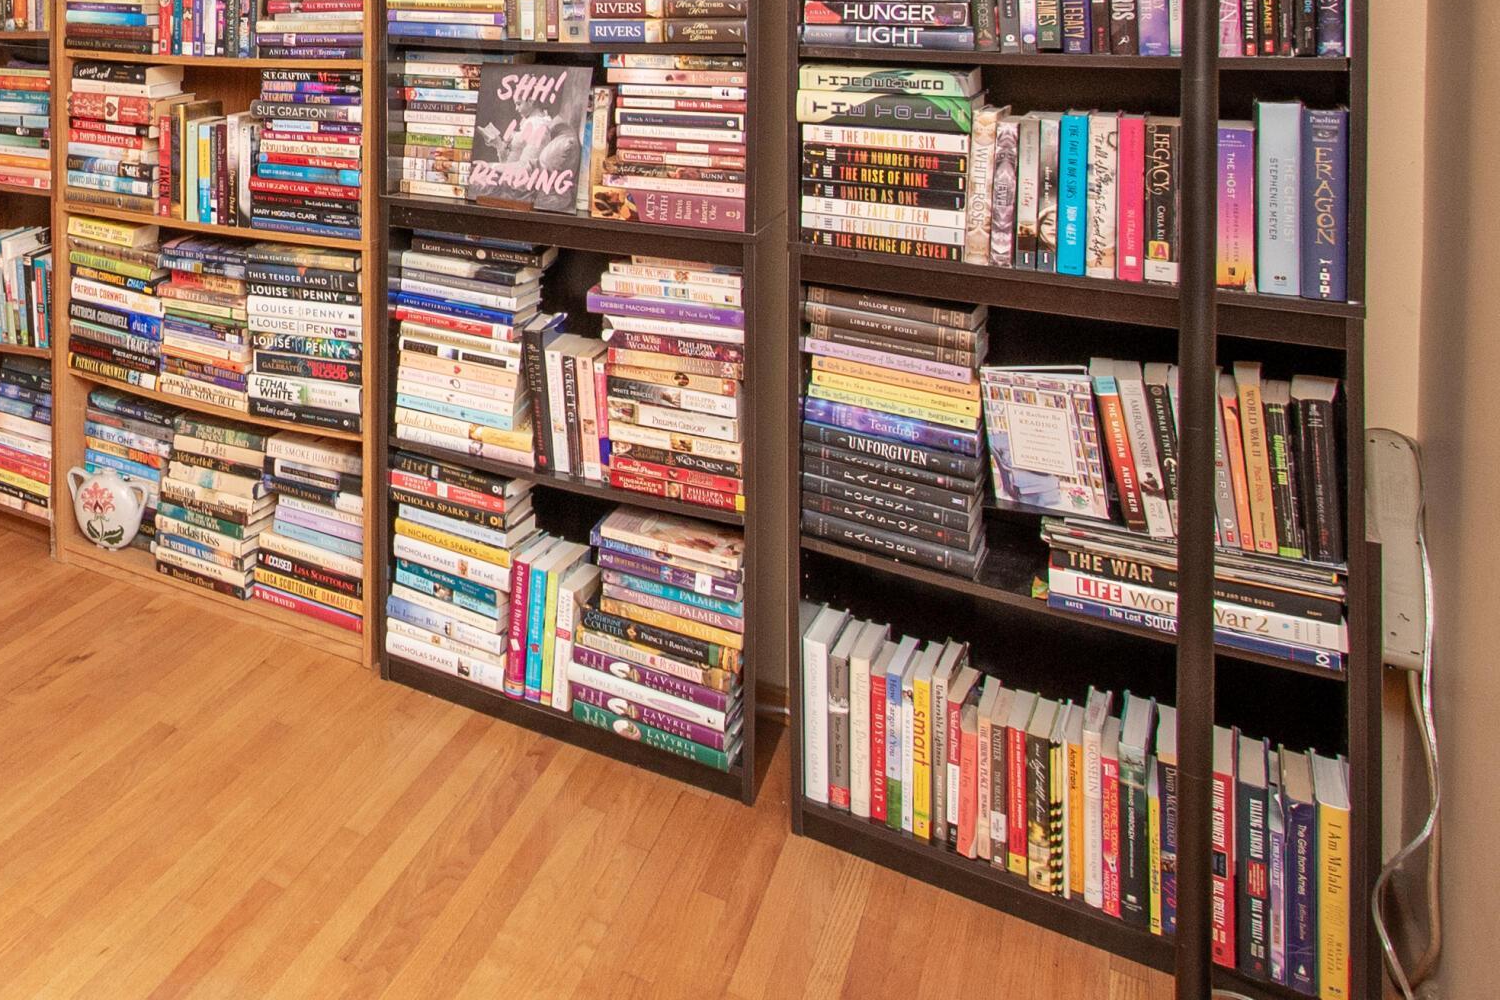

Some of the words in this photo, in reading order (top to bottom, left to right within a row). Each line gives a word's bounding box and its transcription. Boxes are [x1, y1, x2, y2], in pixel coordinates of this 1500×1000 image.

[595, 2, 642, 14] RIVERS
[844, 4, 936, 20] HUNGER
[595, 25, 641, 37] RIVERS
[1063, 1, 1084, 39] LEGACY
[855, 26, 924, 43] LIGHT
[262, 71, 276, 80] SUE
[277, 71, 311, 81] GRAFTON
[497, 71, 567, 105] SHH!
[256, 105, 276, 116] SUE
[277, 107, 327, 118] GRAFTON
[813, 100, 867, 118] THE
[874, 103, 952, 120] TOLL
[841, 130, 858, 143] THE
[863, 132, 900, 146] POWER
[901, 134, 914, 147] OF
[918, 135, 936, 149] SIX
[854, 151, 868, 164] AM
[870, 151, 910, 167] NUMBER
[913, 154, 939, 169] FOUR
[1226, 152, 1236, 170] THE
[159, 164, 170, 199] TAKEN
[469, 159, 574, 195] READING
[840, 166, 858, 180] THE
[861, 168, 884, 184] RISE
[887, 170, 901, 185] OF
[903, 172, 929, 188] NINE
[1226, 171, 1237, 199] HOST
[646, 193, 655, 219] ACTS
[840, 186, 877, 202] UNITED
[880, 189, 893, 204] AS
[898, 190, 919, 206] ONE
[1313, 146, 1337, 245] ERAGON
[659, 194, 669, 221] FAITH
[835, 233, 853, 248] THE
[855, 235, 897, 253] REVENGE
[900, 240, 913, 254] OF
[916, 242, 948, 259] SEVEN
[248, 270, 267, 281] THIS
[268, 272, 301, 284] TENDER
[304, 276, 328, 286] LAND
[73, 282, 98, 298] PATRICIA
[99, 288, 129, 305] CORNWELL
[251, 284, 288, 297] LOUISE
[302, 288, 339, 302] PENNY
[858, 300, 888, 312] HOLLOW
[889, 305, 906, 314] CITY
[252, 335, 291, 350] LOUISE
[305, 341, 343, 356] PENNY
[75, 356, 99, 374] PATRICIA
[99, 361, 128, 381] CORNWELL
[311, 367, 349, 380] BLOOD
[255, 376, 288, 391] LETHAL
[259, 387, 294, 402] WHITE
[1107, 402, 1118, 417] THE
[869, 417, 920, 440] Teardrop
[1111, 420, 1126, 458] MARTIAN
[847, 435, 928, 466] UNFORGIVEN
[844, 471, 916, 496] FALLEN
[1121, 465, 1133, 489] ANDY
[1127, 492, 1139, 513] WEIR
[392, 491, 435, 511] NICHOLAS
[436, 501, 470, 518] SPARKS
[844, 489, 915, 512] TORMENT
[844, 507, 919, 533] PASSION
[844, 530, 917, 555] RAPTURE
[1068, 550, 1104, 572] THE
[1111, 559, 1154, 583] WAR
[680, 605, 722, 624] PALMER
[1079, 578, 1120, 601] LIFE
[1129, 589, 1175, 615] Wor
[1255, 615, 1269, 633] 2
[1108, 606, 1122, 618] The
[1123, 610, 1142, 624] Lost
[1145, 615, 1176, 633] SQUA
[913, 710, 930, 767] smart
[1212, 779, 1225, 810] KILLING
[1212, 812, 1225, 848] KENNEDY
[1328, 834, 1342, 851] Am
[1327, 857, 1342, 894] Malala
